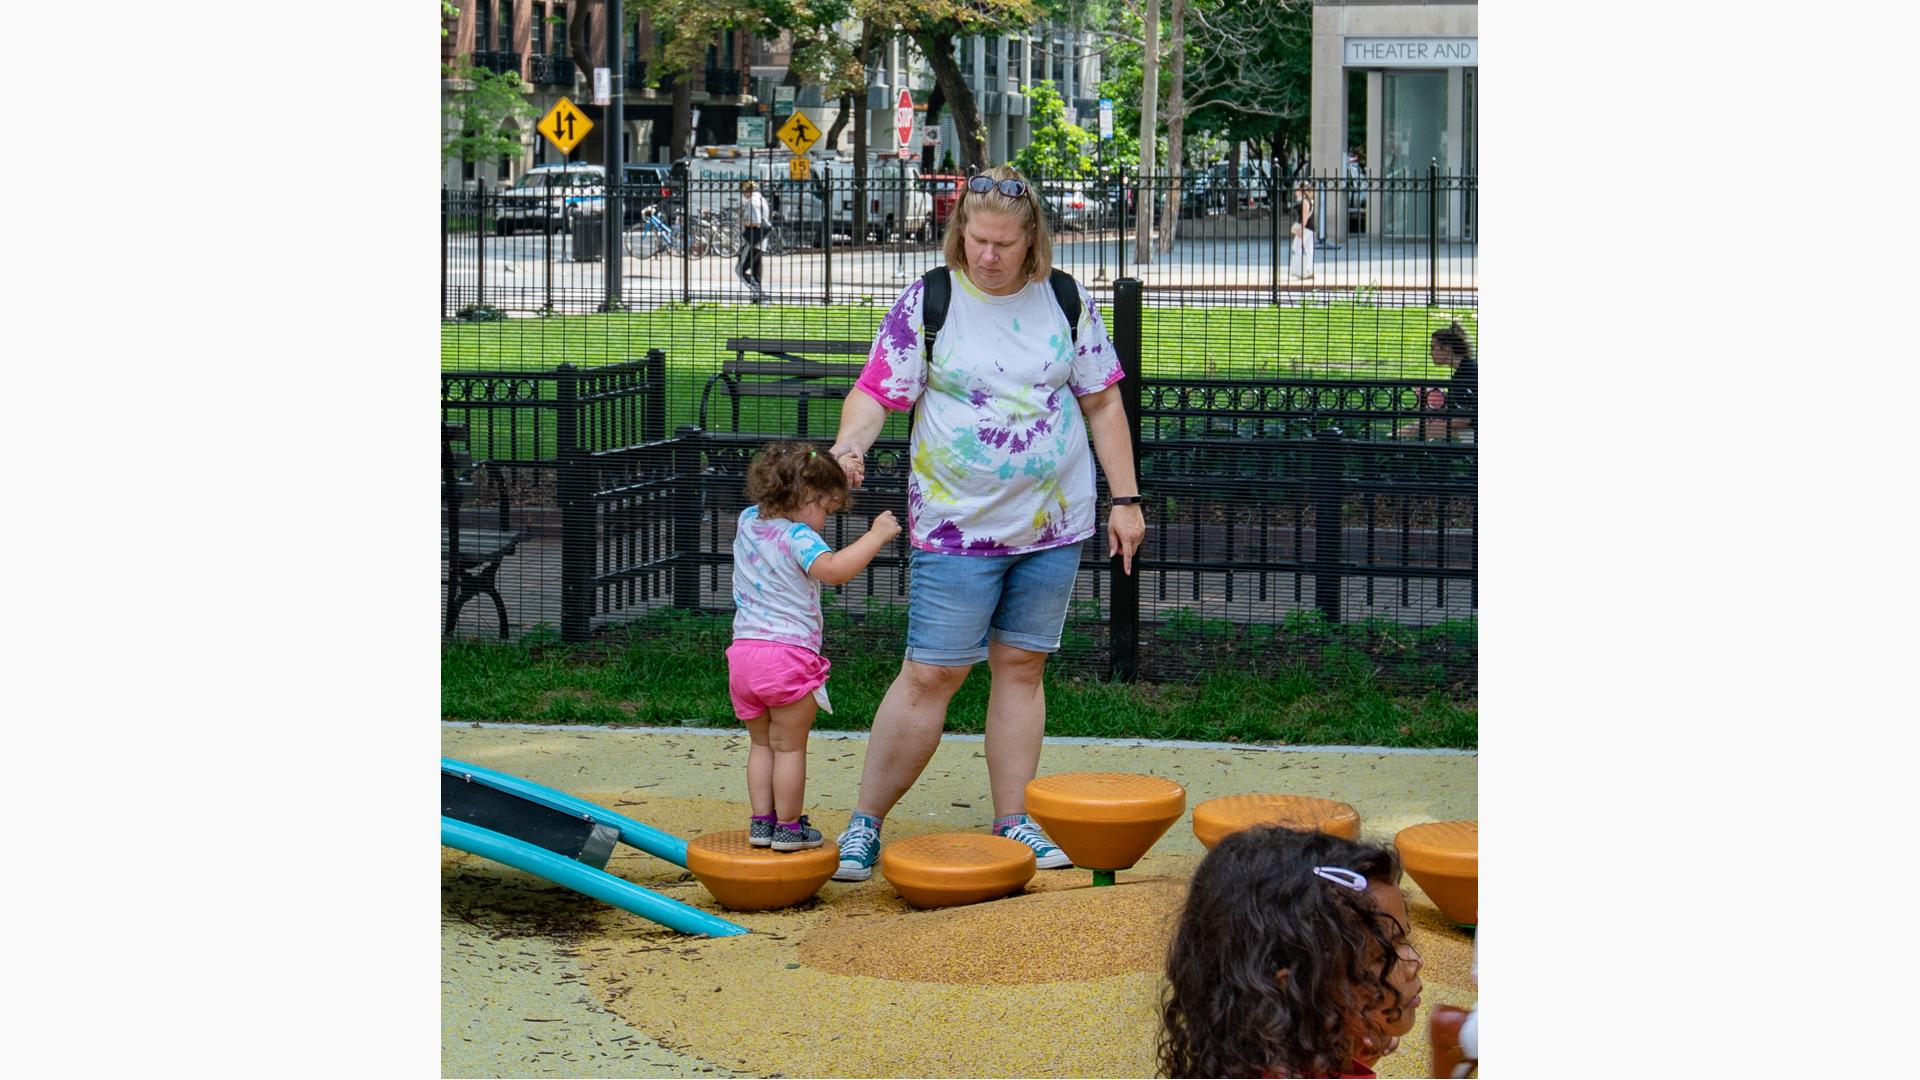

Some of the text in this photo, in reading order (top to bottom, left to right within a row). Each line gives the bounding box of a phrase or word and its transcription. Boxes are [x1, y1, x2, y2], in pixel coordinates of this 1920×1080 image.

[1352, 43, 1471, 59] THEATER AND
[898, 106, 912, 128] STOP
[793, 160, 806, 172] 15
